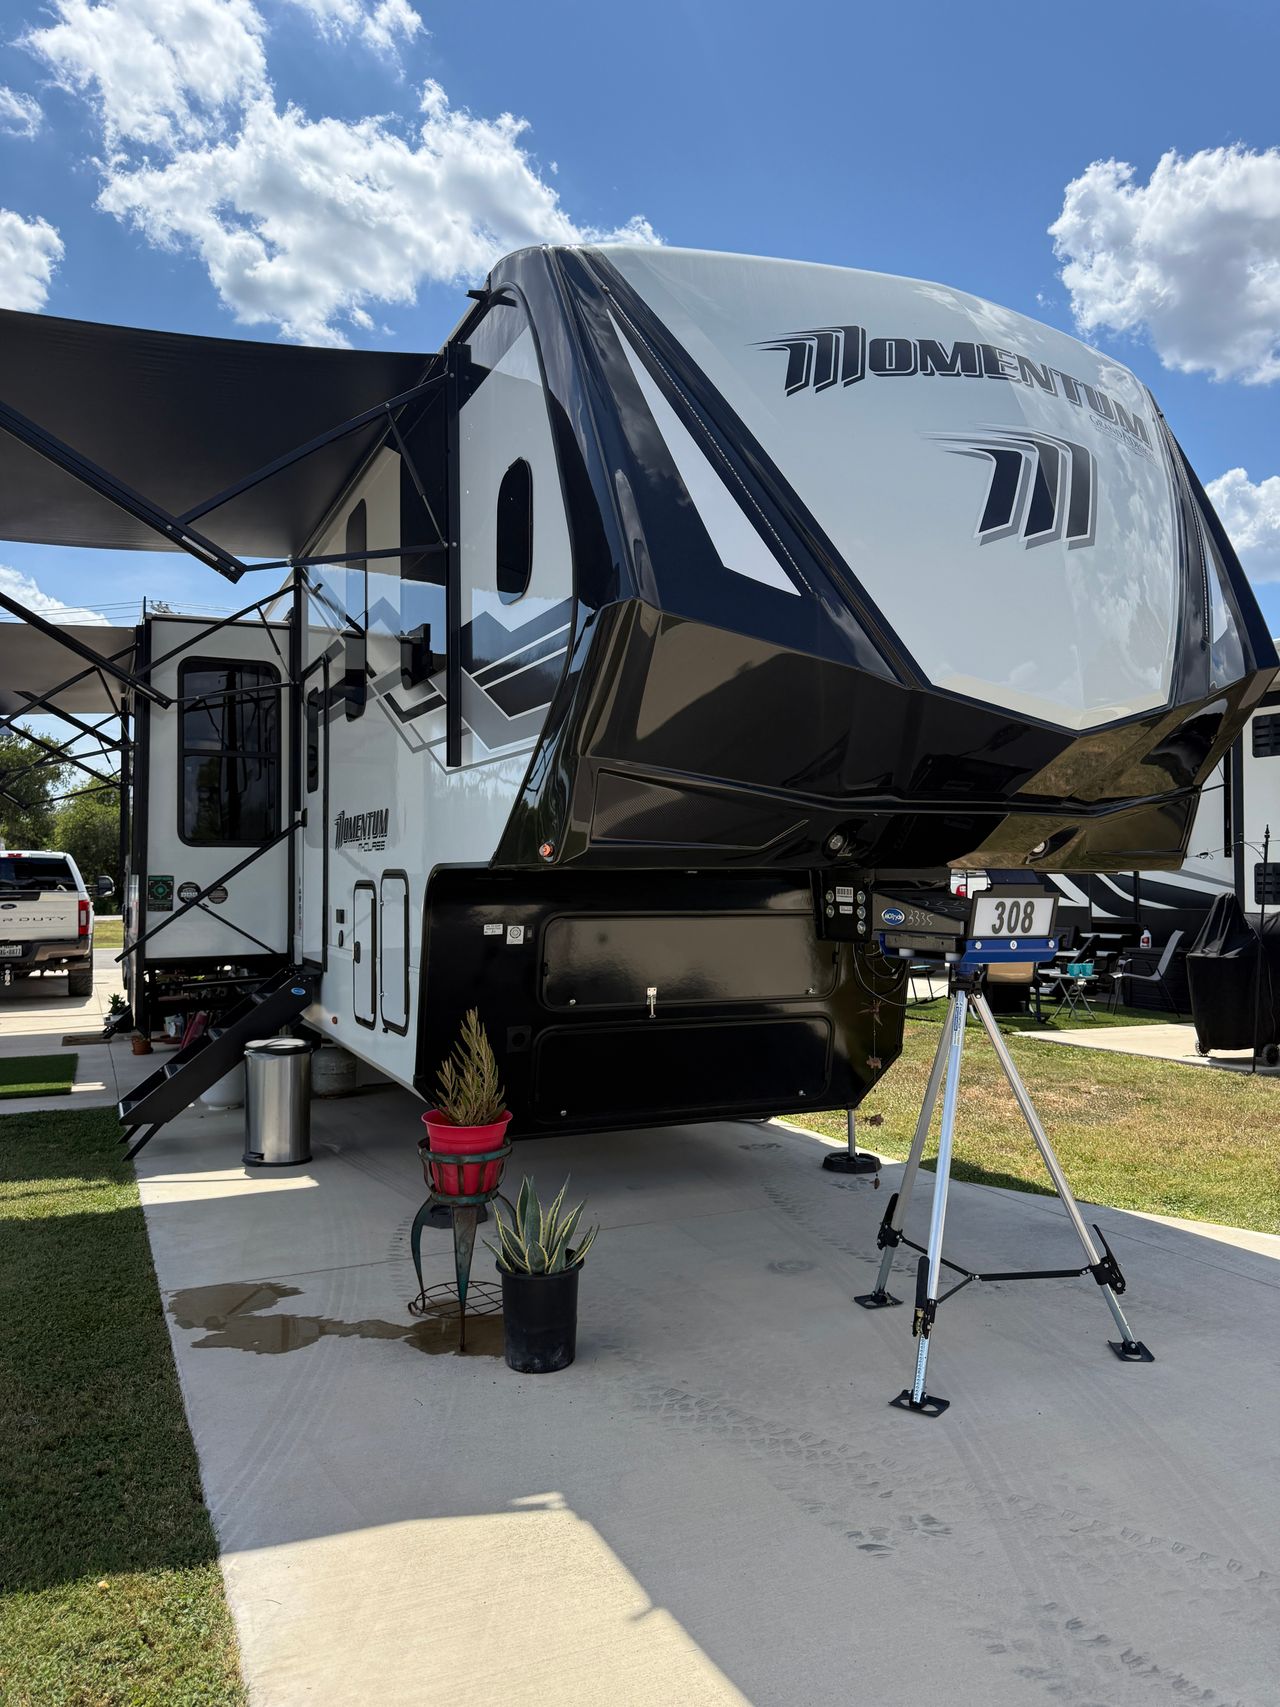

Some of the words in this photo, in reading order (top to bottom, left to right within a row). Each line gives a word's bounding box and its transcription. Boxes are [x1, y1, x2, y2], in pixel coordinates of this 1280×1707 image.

[746, 325, 1154, 451] MOMENTUM
[334, 808, 389, 850] MOMENTUM
[991, 900, 1035, 934] 308
